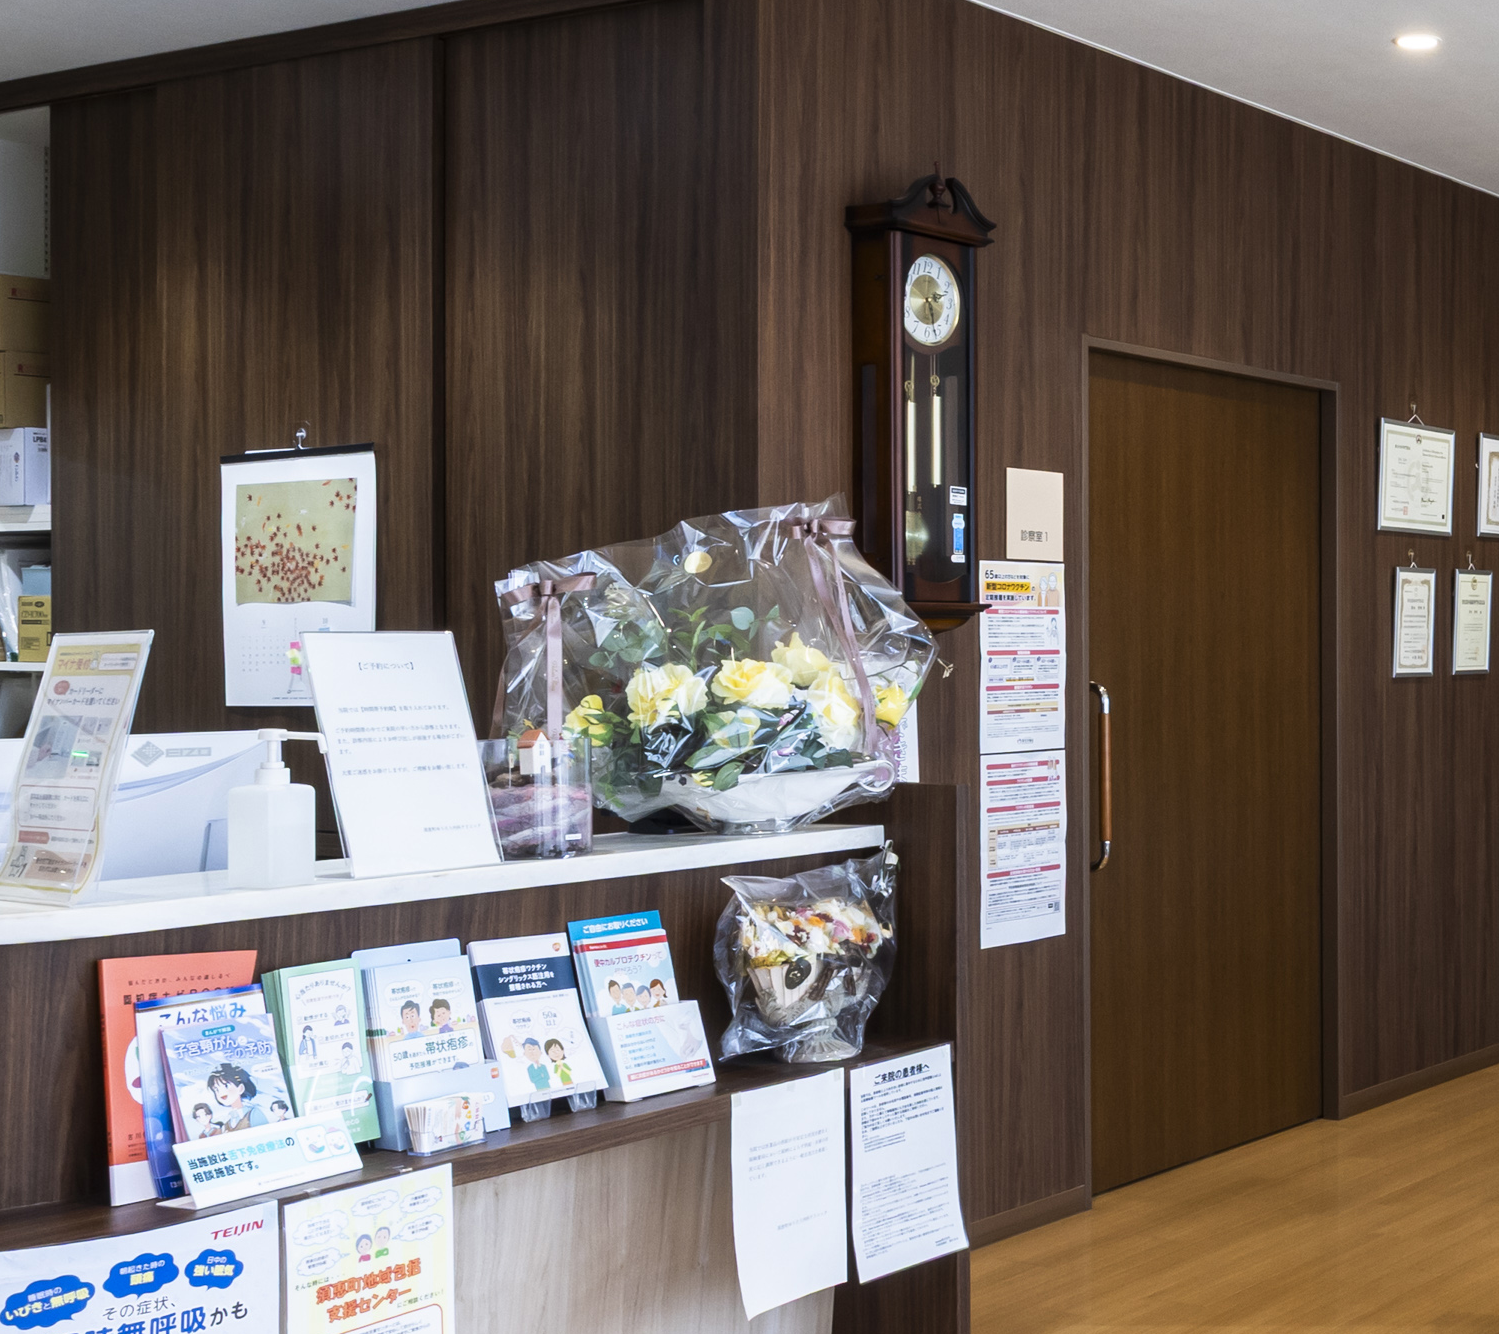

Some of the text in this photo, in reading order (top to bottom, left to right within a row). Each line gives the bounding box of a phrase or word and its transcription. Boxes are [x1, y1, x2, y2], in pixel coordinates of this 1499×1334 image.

[912, 263, 921, 275] 11
[923, 260, 934, 274] 12
[944, 281, 951, 294] 2
[946, 298, 954, 310] 3
[912, 320, 920, 334] 7
[924, 326, 931, 338] 6
[1020, 529, 1050, 544] 診察室1
[358, 662, 415, 671] 【ご予約について】
[165, 747, 212, 758] EIZO
[582, 918, 648, 934] ご自由にお取りください
[502, 963, 547, 974] 帯状疱疹ワクチン
[158, 1002, 247, 1027] こんな悩み
[616, 1015, 666, 1031] こんな症状の方に
[204, 1026, 232, 1036] まんがで解説
[224, 1043, 273, 1061] その予防
[409, 1055, 461, 1070] 予防接種ができます。
[874, 1063, 930, 1085] ご来院の患者様へ
[187, 1136, 295, 1171] 当施設は舌下免疫療法の
[192, 1162, 260, 1184] 相談施設です。
[210, 1220, 265, 1240] TEIJIN
[206, 1255, 227, 1264] 日中の
[119, 1260, 166, 1275] 朝起きた時の
[193, 1265, 235, 1277] 強い眠気
[129, 1271, 155, 1286] 頭痛
[315, 1257, 422, 1305] 須恵町地域包括
[27, 1286, 62, 1302] 睡眠時の
[5, 1287, 90, 1321] いびきと無呼吸
[102, 1296, 177, 1321] その症状、
[326, 1288, 412, 1324] 支援センター
